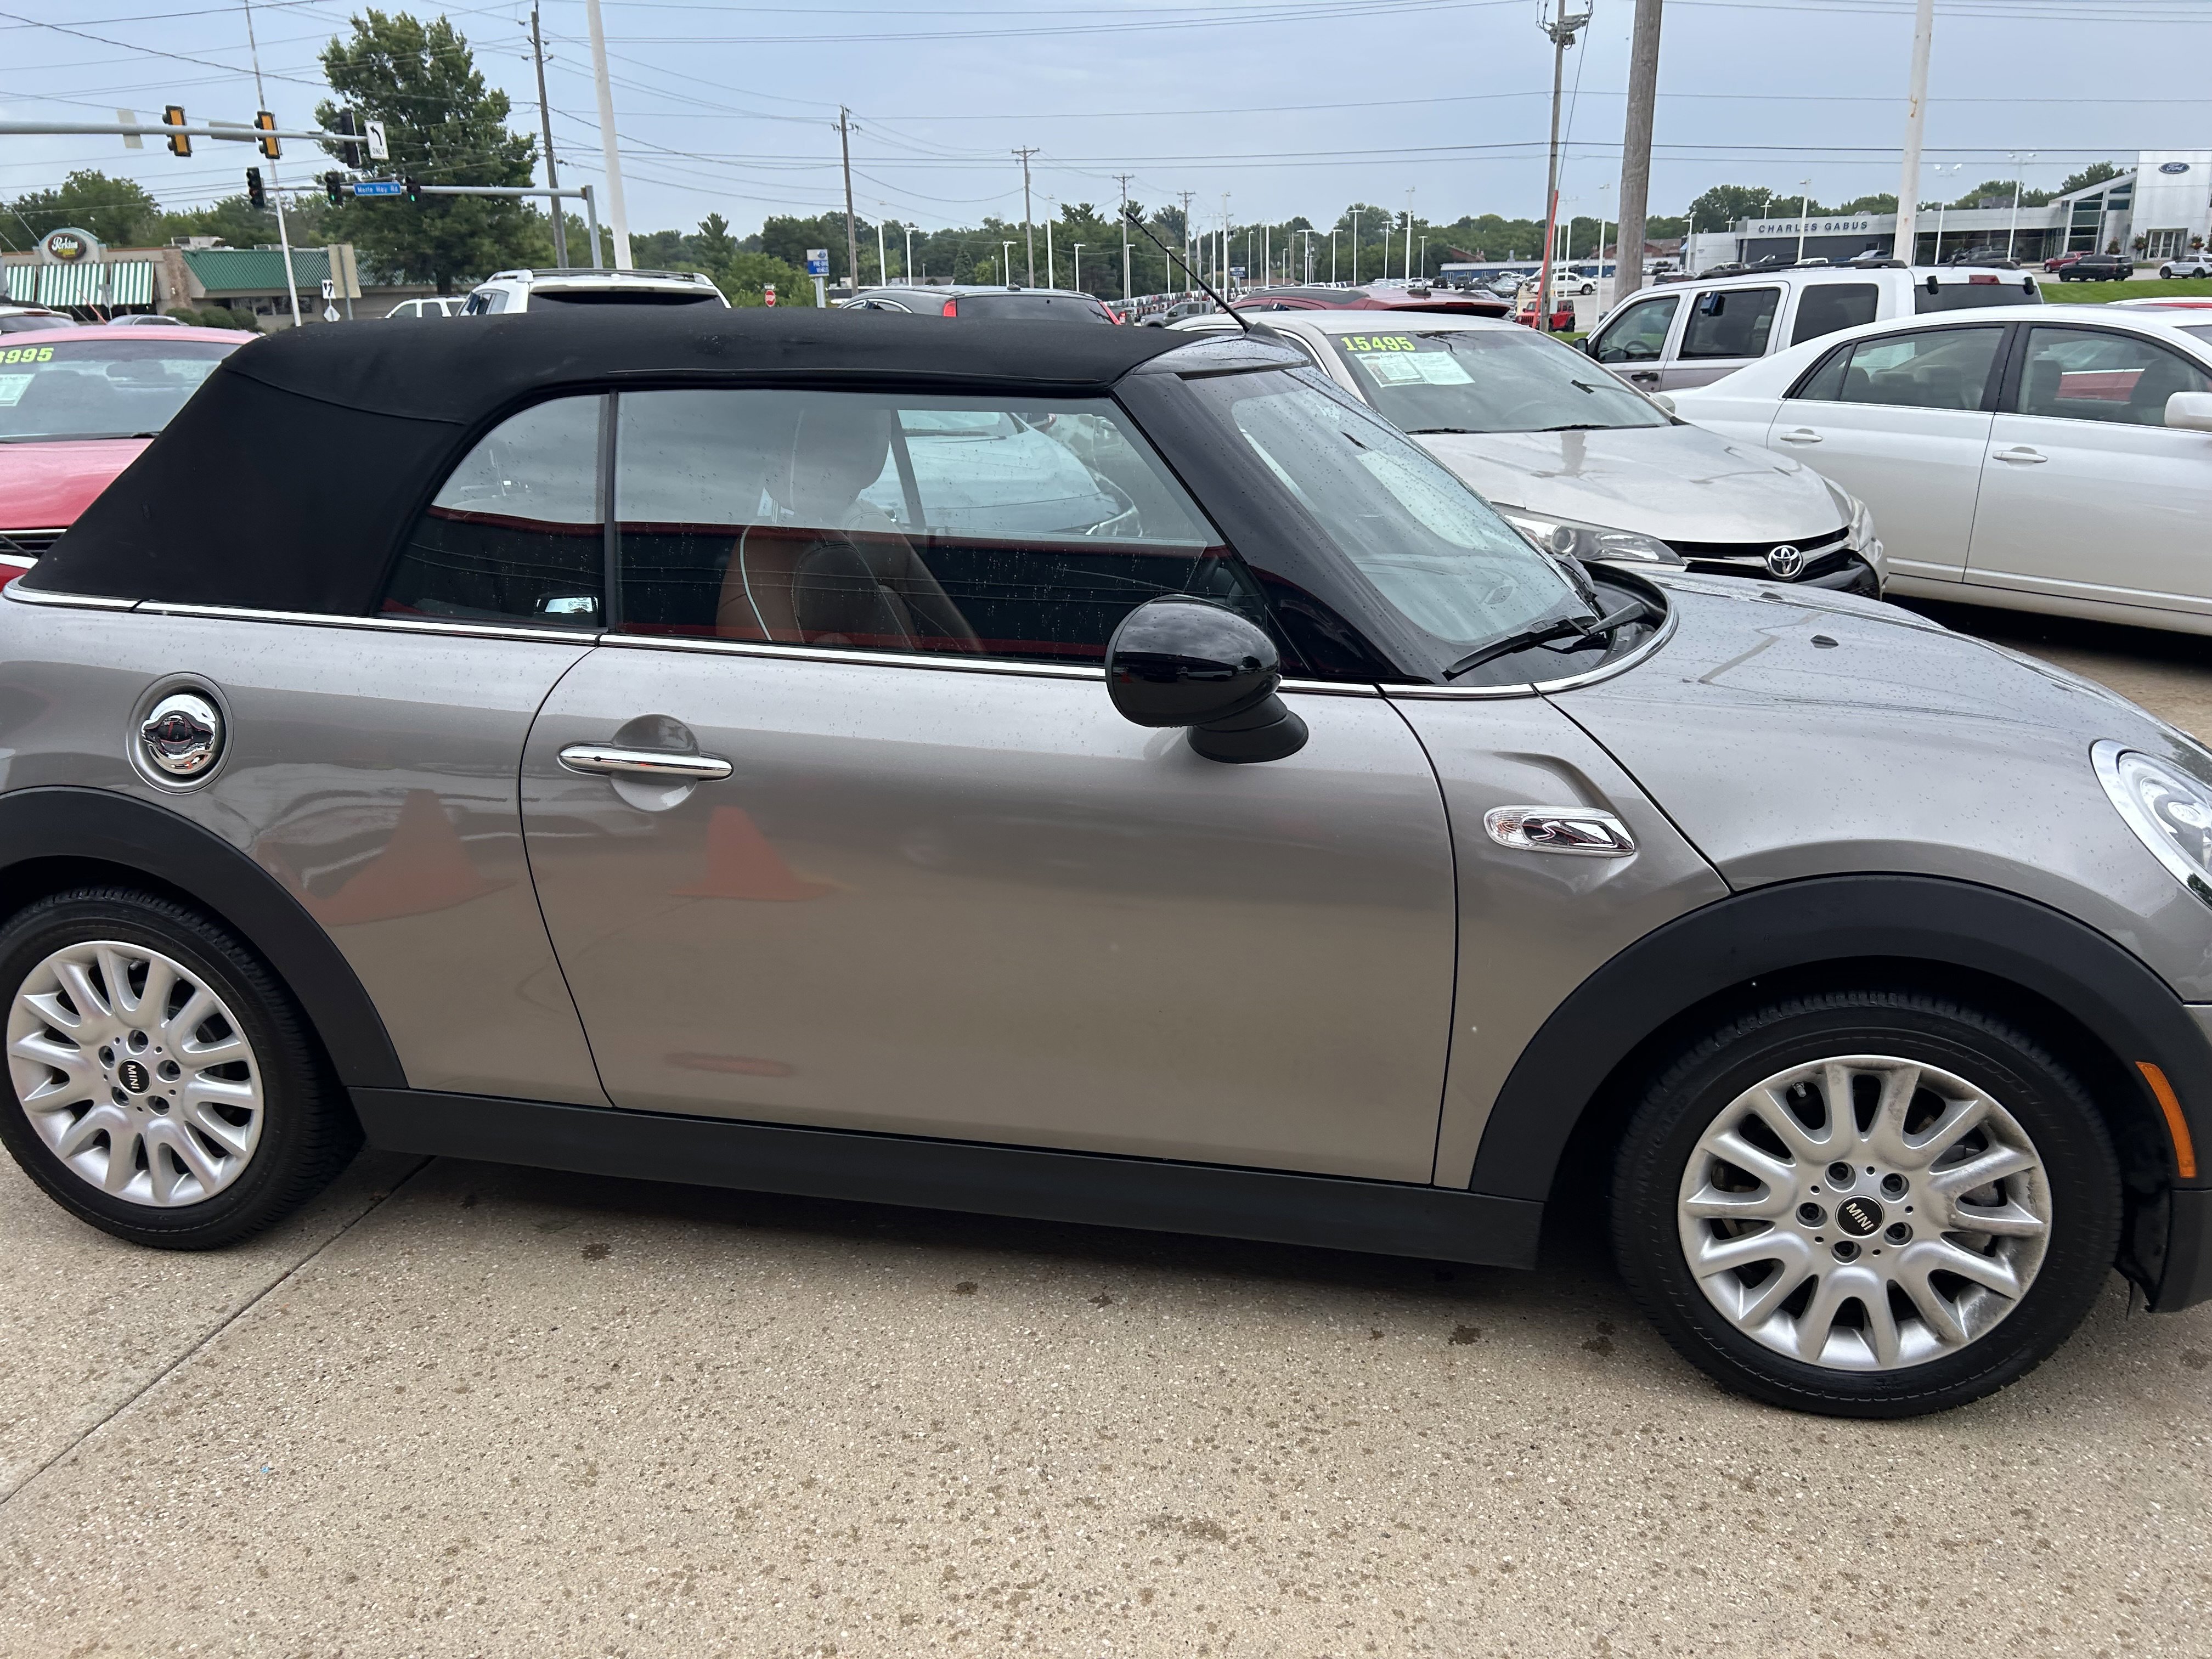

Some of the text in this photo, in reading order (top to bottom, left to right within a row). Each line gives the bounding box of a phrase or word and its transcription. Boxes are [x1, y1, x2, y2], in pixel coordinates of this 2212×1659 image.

[1759, 221, 1867, 233] CHARLES GABUS
[51, 236, 78, 251] Perkins
[1341, 336, 1416, 351] 15495
[127, 1064, 140, 1090] MINI
[1846, 1202, 1875, 1231] MINI
